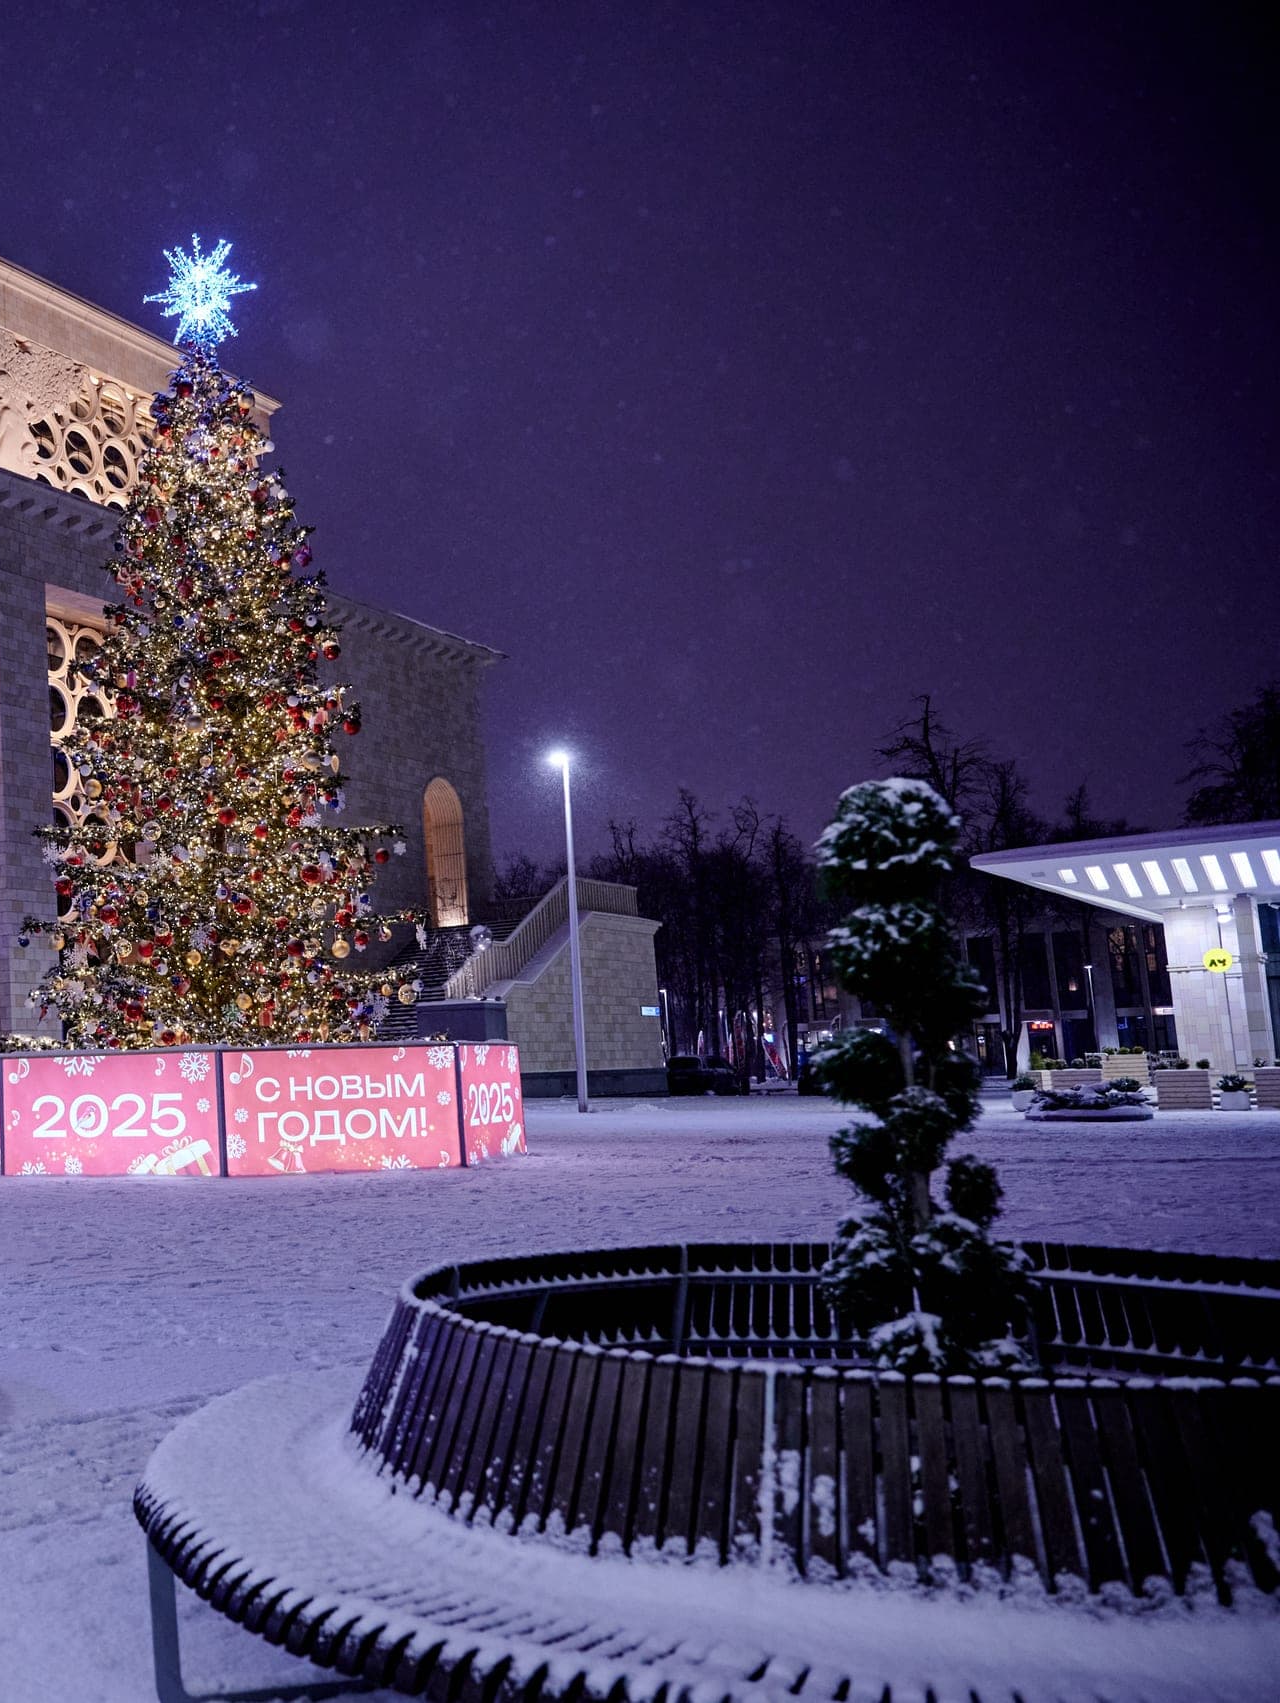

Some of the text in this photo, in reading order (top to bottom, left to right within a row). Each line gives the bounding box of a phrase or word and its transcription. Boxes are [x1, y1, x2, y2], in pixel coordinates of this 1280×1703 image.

[255, 1073, 426, 1102] С НОВЫМ
[468, 1082, 514, 1127] 2025
[31, 1092, 187, 1138] 2025
[257, 1107, 428, 1147] ГОДОМ!
